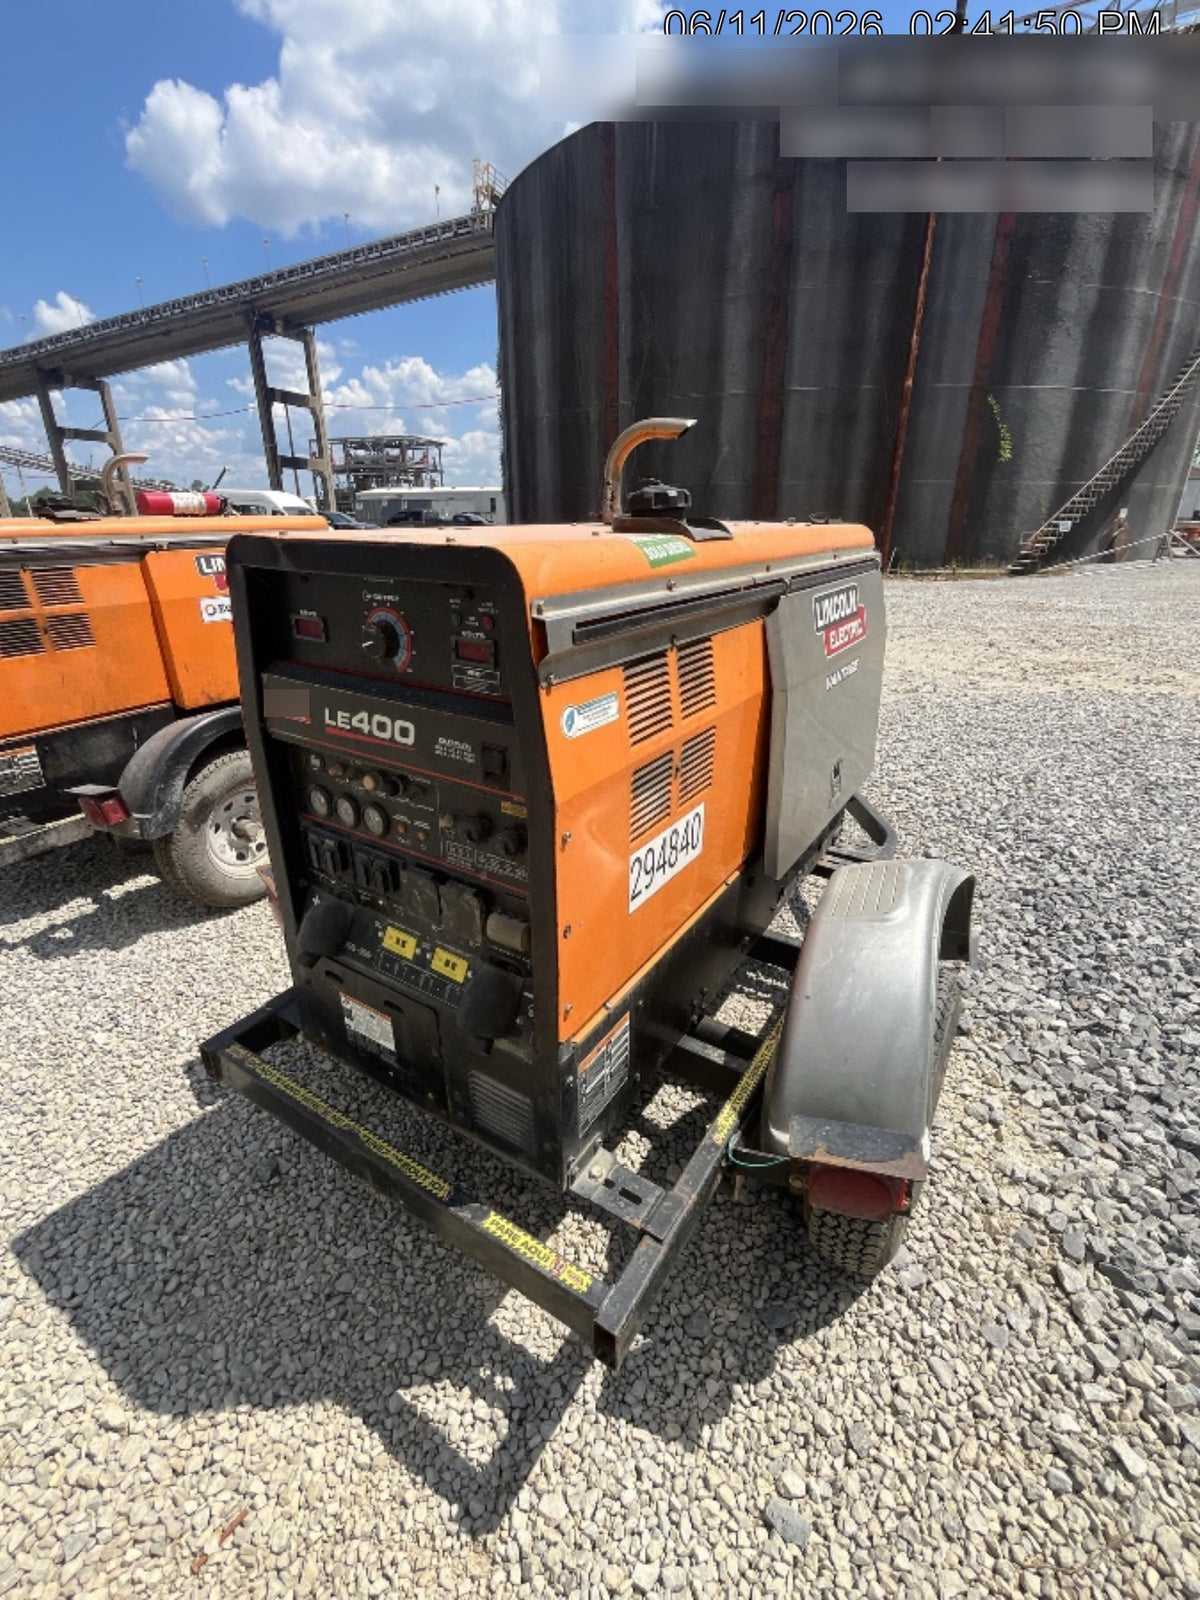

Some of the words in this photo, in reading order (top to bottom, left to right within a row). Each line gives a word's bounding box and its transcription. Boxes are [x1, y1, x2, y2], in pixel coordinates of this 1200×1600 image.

[816, 589, 857, 629] LINCOLN
[829, 618, 864, 650] ELECTRIC
[325, 707, 416, 746] LE400
[630, 811, 702, 902] 294840
